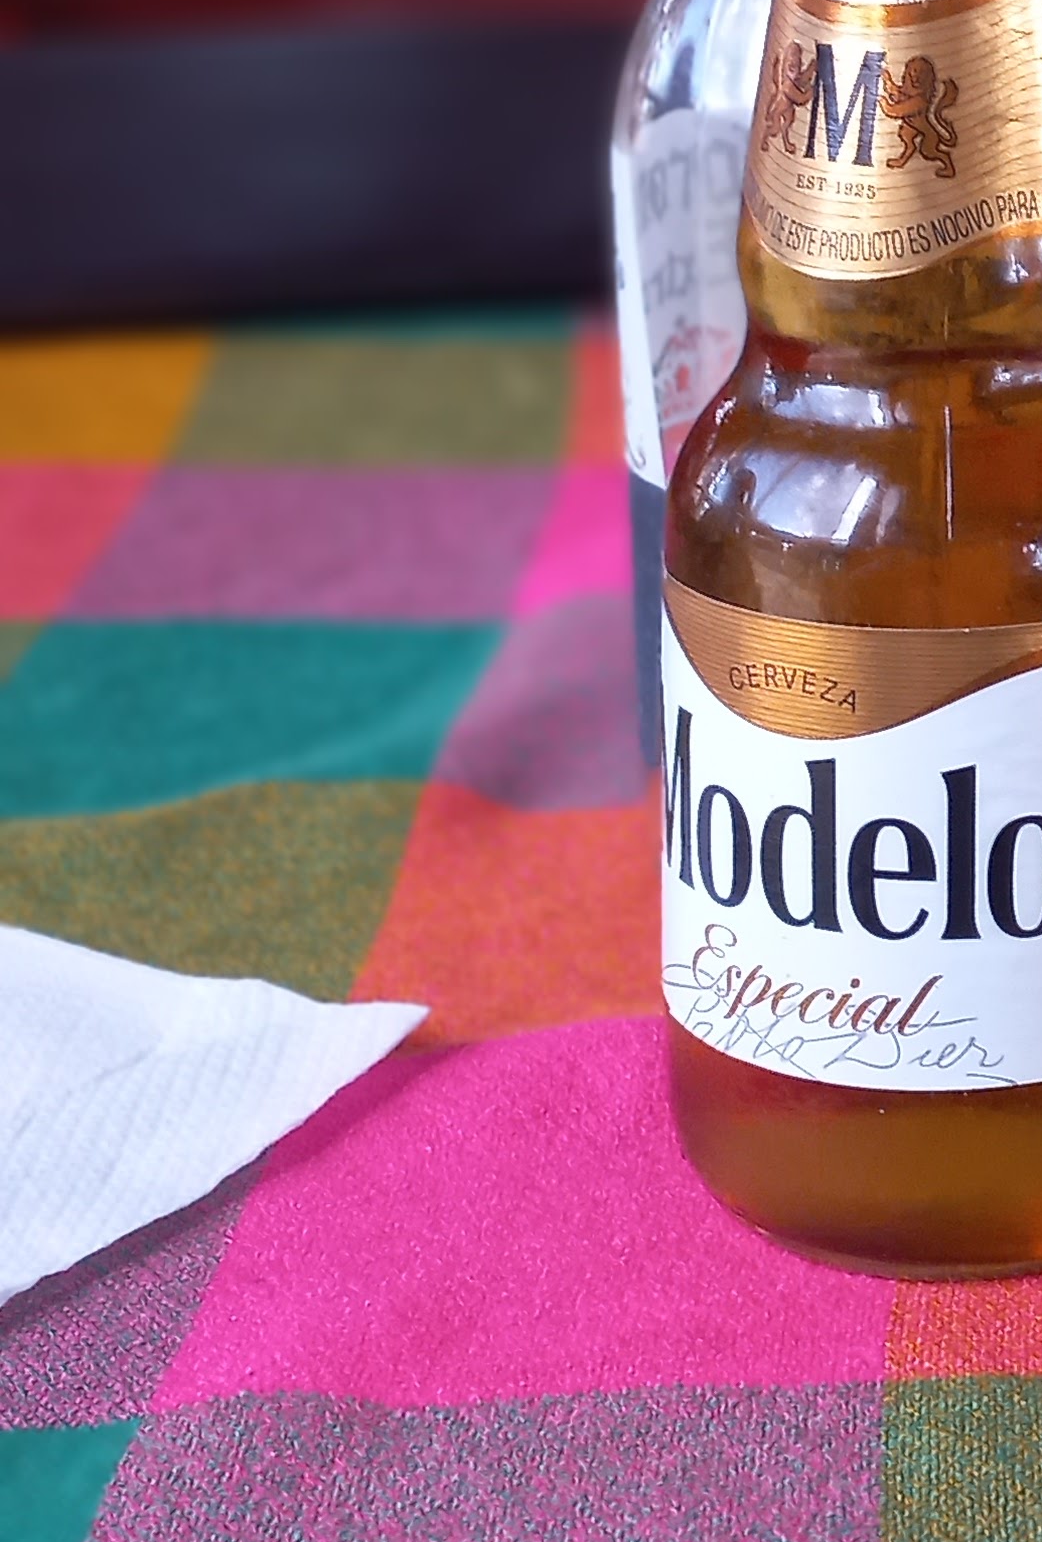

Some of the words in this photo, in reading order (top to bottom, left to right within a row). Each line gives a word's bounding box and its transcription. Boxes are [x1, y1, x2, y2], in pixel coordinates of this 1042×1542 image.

[803, 39, 888, 167] M
[785, 219, 818, 256] ESTE
[820, 230, 904, 261] PRODUCTO
[906, 225, 931, 254] ES
[930, 199, 995, 247] NOCIVO
[996, 190, 1040, 223] PARA
[729, 663, 857, 713] CERVEZA
[692, 923, 944, 1037] Especial
